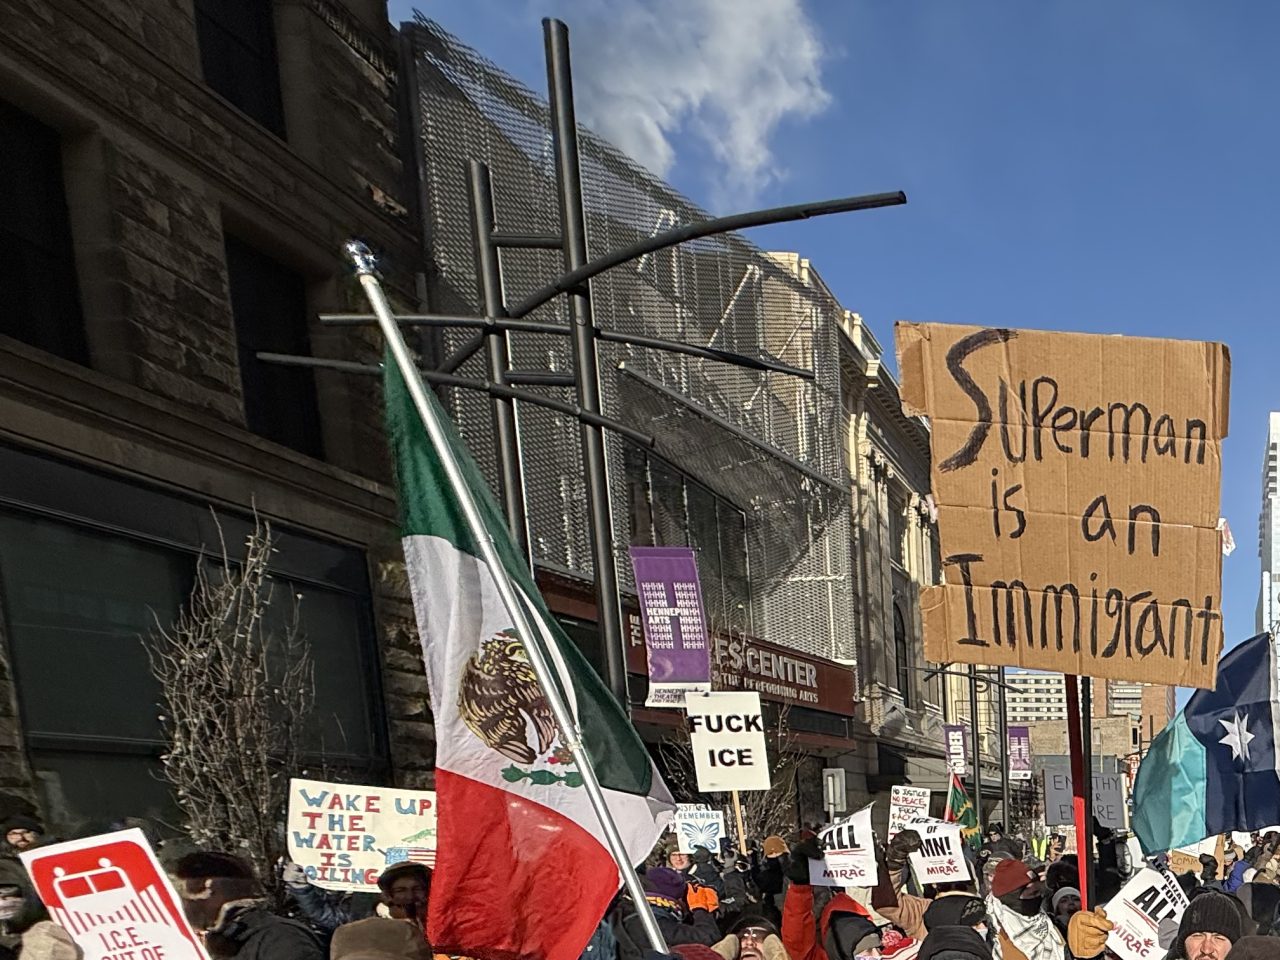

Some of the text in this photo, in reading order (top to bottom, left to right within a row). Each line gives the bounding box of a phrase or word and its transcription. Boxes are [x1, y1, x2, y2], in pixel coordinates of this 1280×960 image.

[990, 468, 1161, 557] is an
[646, 608, 689, 616] HENNEPIN
[942, 553, 1220, 665] Immigrant
[747, 647, 818, 688] CENTER
[743, 677, 797, 699] PERFORMING
[799, 689, 818, 703] ARTS
[688, 714, 763, 733] FUCK
[708, 749, 754, 767] ICE
[300, 789, 380, 813] WAKE
[302, 812, 365, 832] THE
[927, 826, 938, 834] OF
[293, 831, 376, 851] WATER
[824, 825, 860, 850] ALL
[921, 837, 952, 857] MN!
[320, 853, 352, 867] IS
[927, 865, 959, 875] MIRAC
[823, 868, 865, 879] MIRAC
[1133, 886, 1176, 924] ALL
[1161, 885, 1179, 907] FOR
[99, 927, 148, 951] I.C.E.
